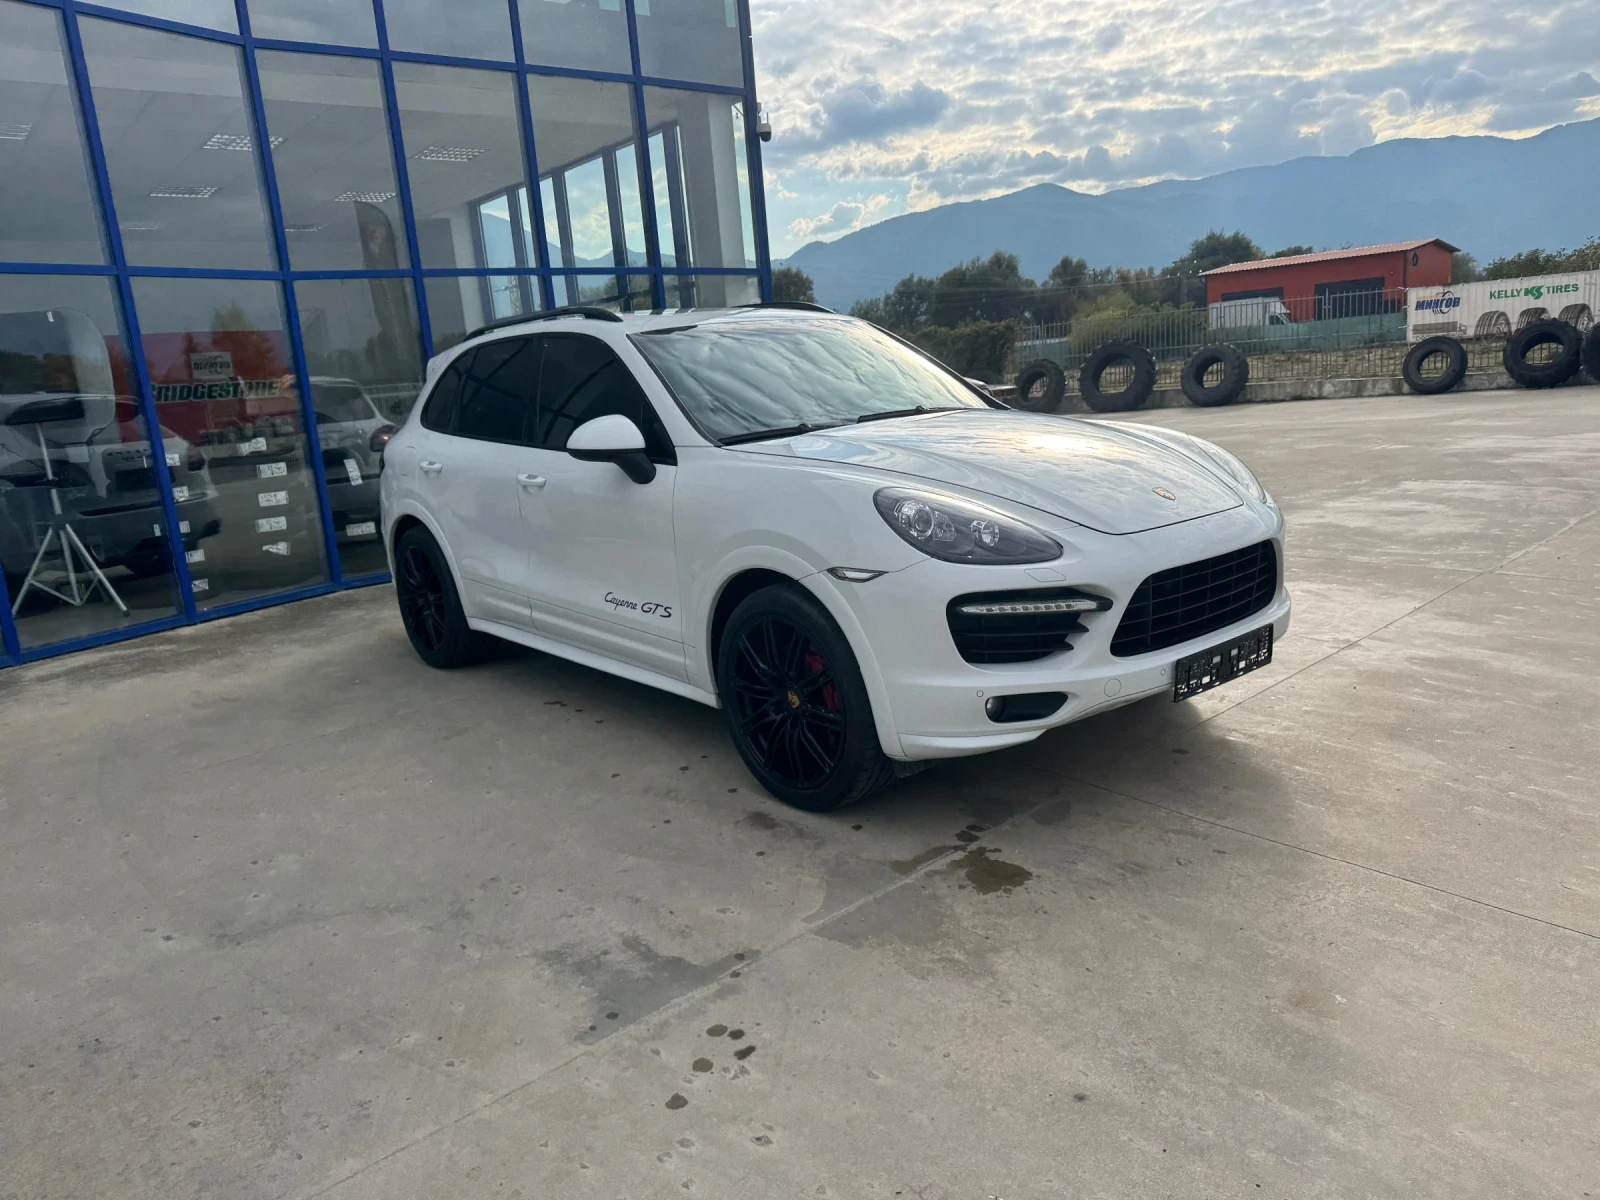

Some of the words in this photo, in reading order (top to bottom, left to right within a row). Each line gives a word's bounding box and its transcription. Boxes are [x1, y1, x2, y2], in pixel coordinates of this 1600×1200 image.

[1489, 288, 1523, 300] KELLY
[1545, 283, 1579, 295] TIRES
[1415, 296, 1461, 311] МИНГОВ
[604, 591, 638, 611] Cayenne
[640, 602, 673, 618] GTS
